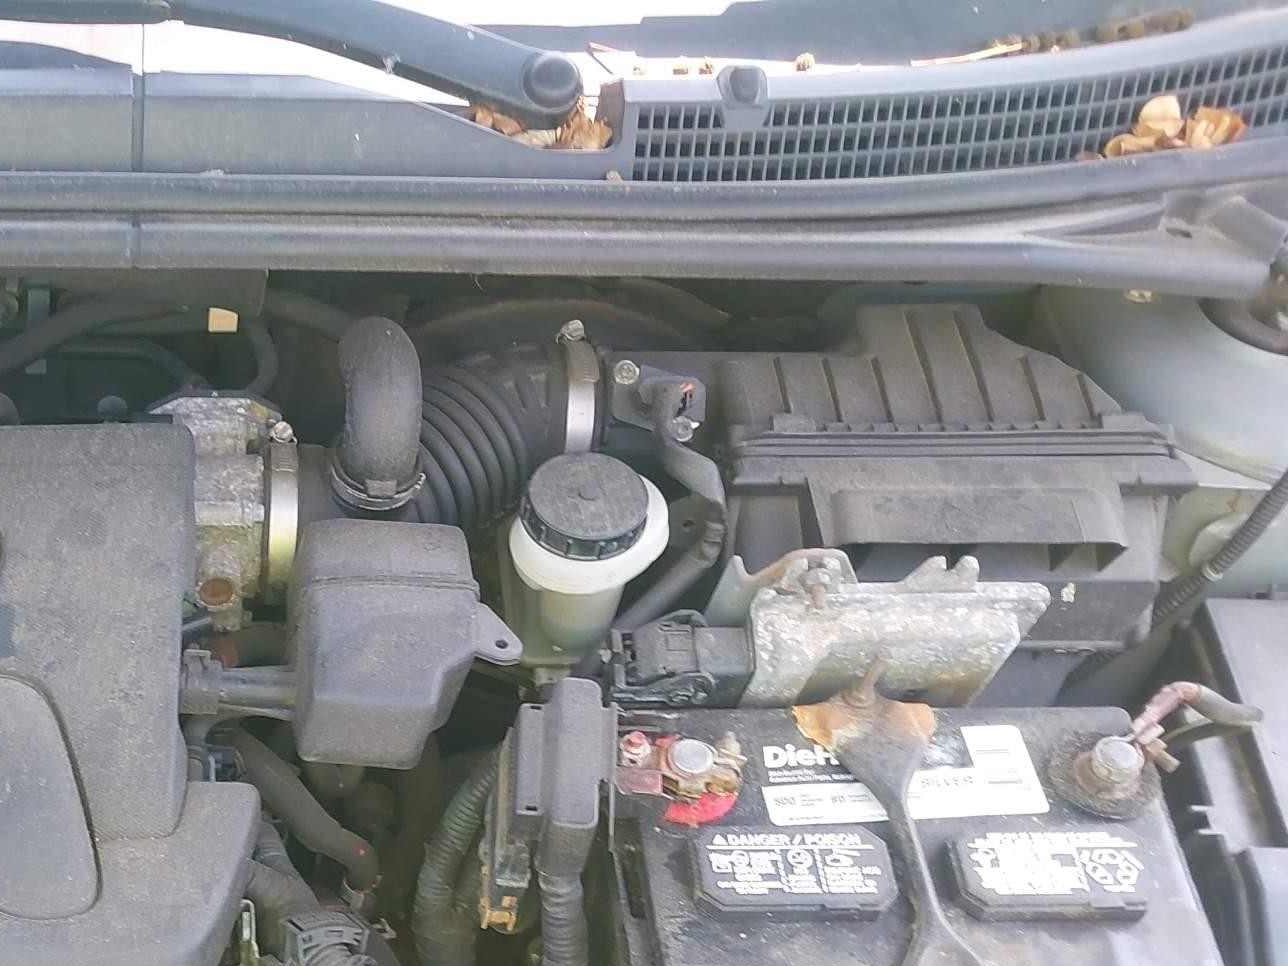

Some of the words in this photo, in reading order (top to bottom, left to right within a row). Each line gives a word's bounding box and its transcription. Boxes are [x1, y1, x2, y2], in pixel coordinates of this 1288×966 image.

[762, 743, 841, 769] DieH
[726, 833, 791, 846] DANGER
[803, 832, 863, 847] POISON
